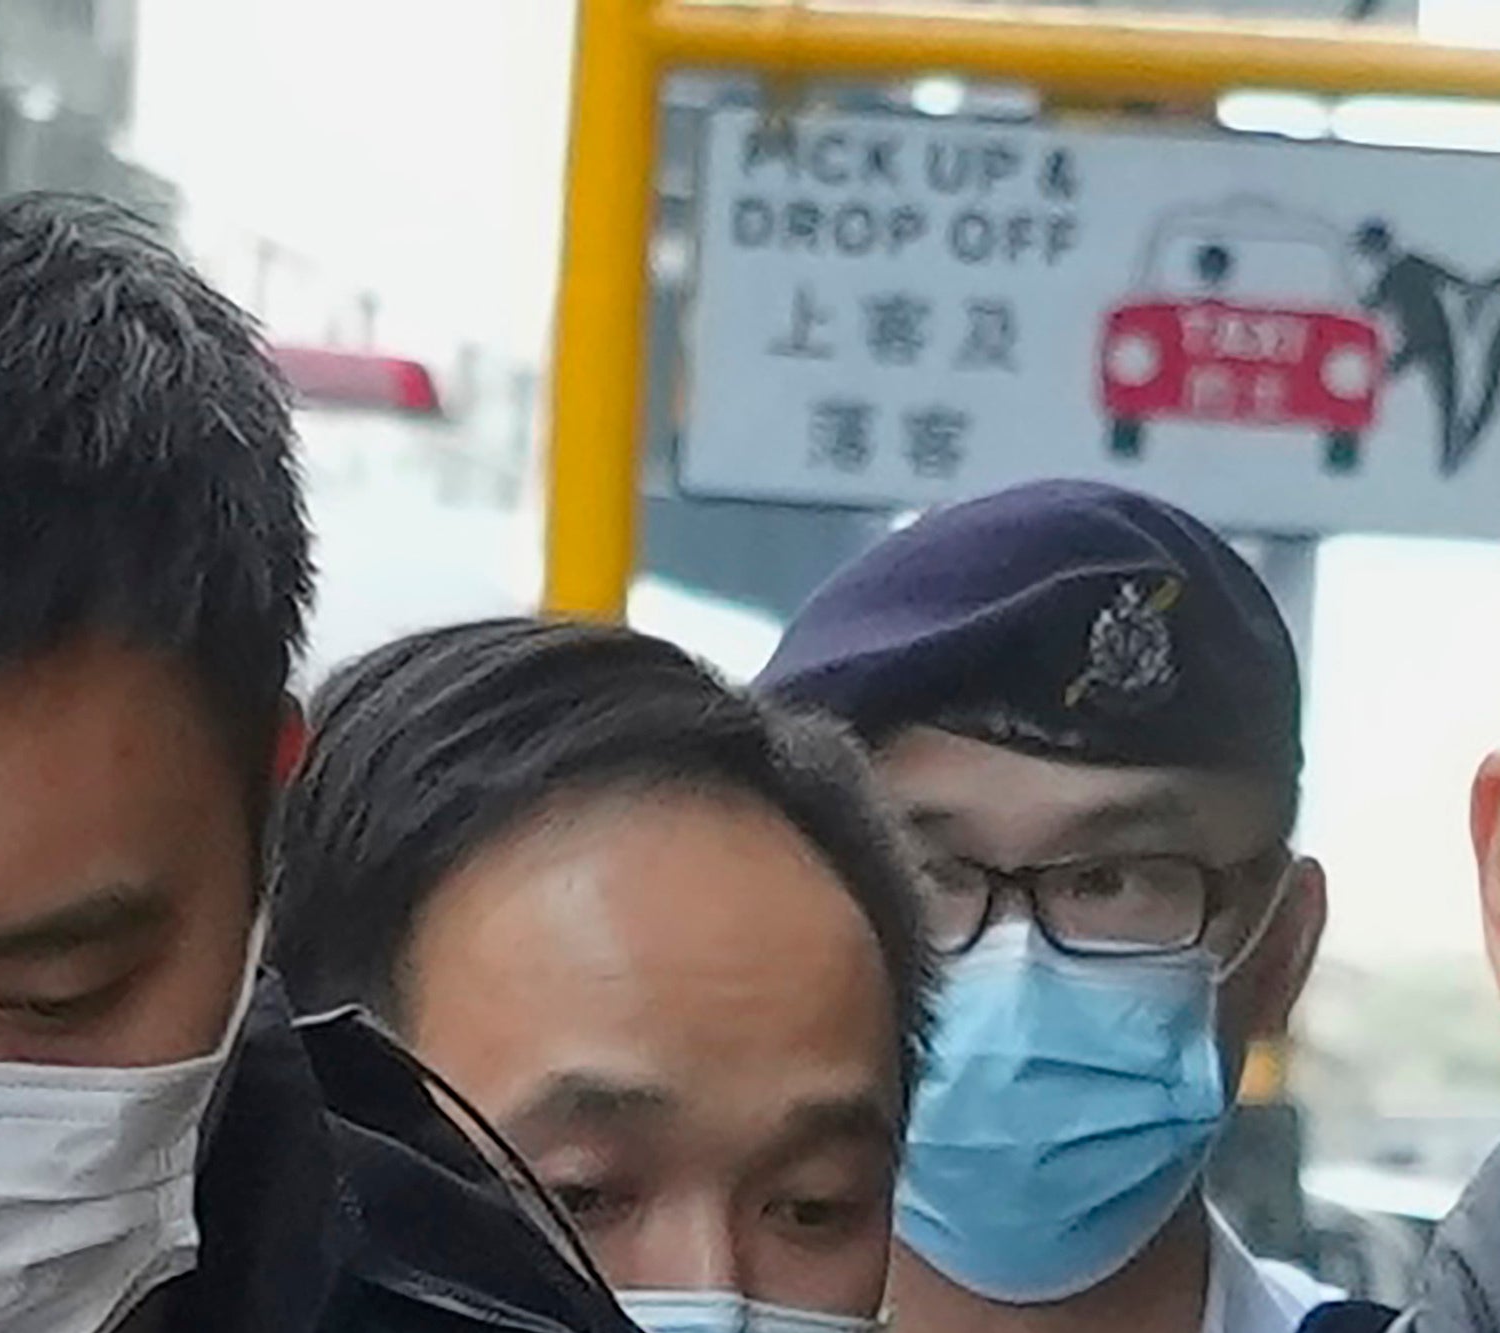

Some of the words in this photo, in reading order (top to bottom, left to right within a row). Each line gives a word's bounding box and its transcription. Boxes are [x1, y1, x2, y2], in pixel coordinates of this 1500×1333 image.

[924, 138, 1021, 194] UP
[729, 197, 926, 256] DROP
[947, 206, 1079, 265] OFF
